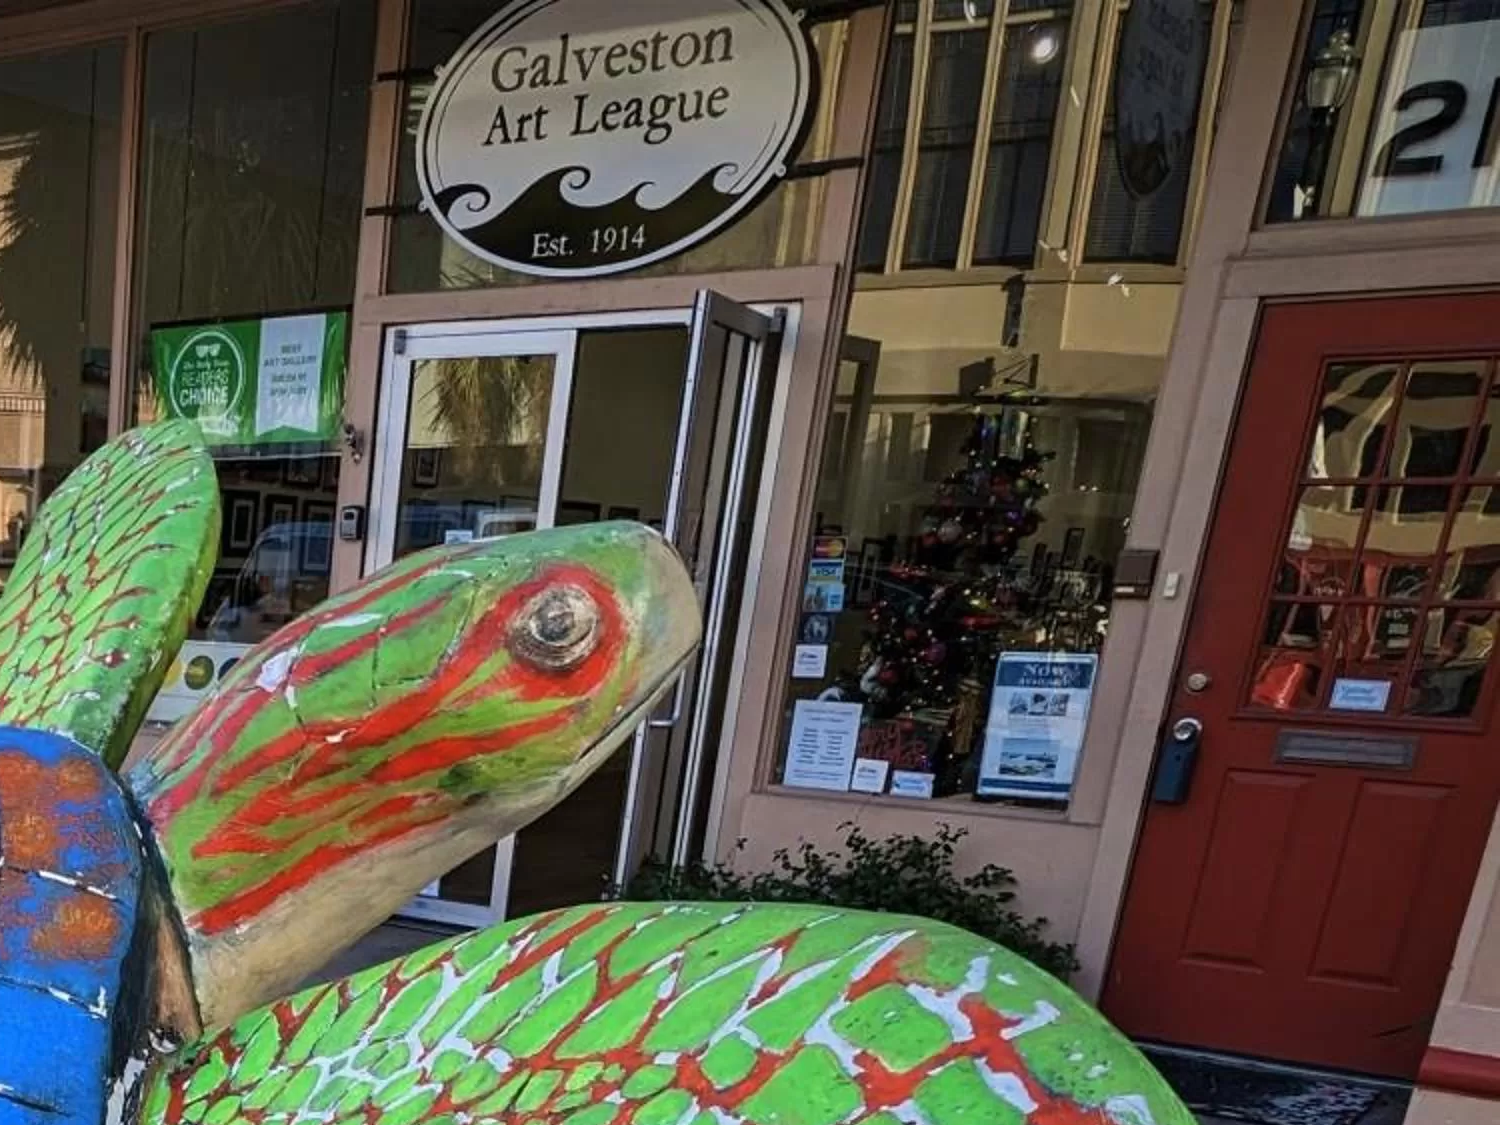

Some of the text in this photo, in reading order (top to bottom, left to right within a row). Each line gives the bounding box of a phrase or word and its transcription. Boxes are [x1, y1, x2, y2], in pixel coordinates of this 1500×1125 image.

[490, 25, 734, 94] Galveston
[481, 84, 730, 147] Art League
[531, 224, 647, 258] Est. 1914
[180, 385, 229, 407] CHOICE
